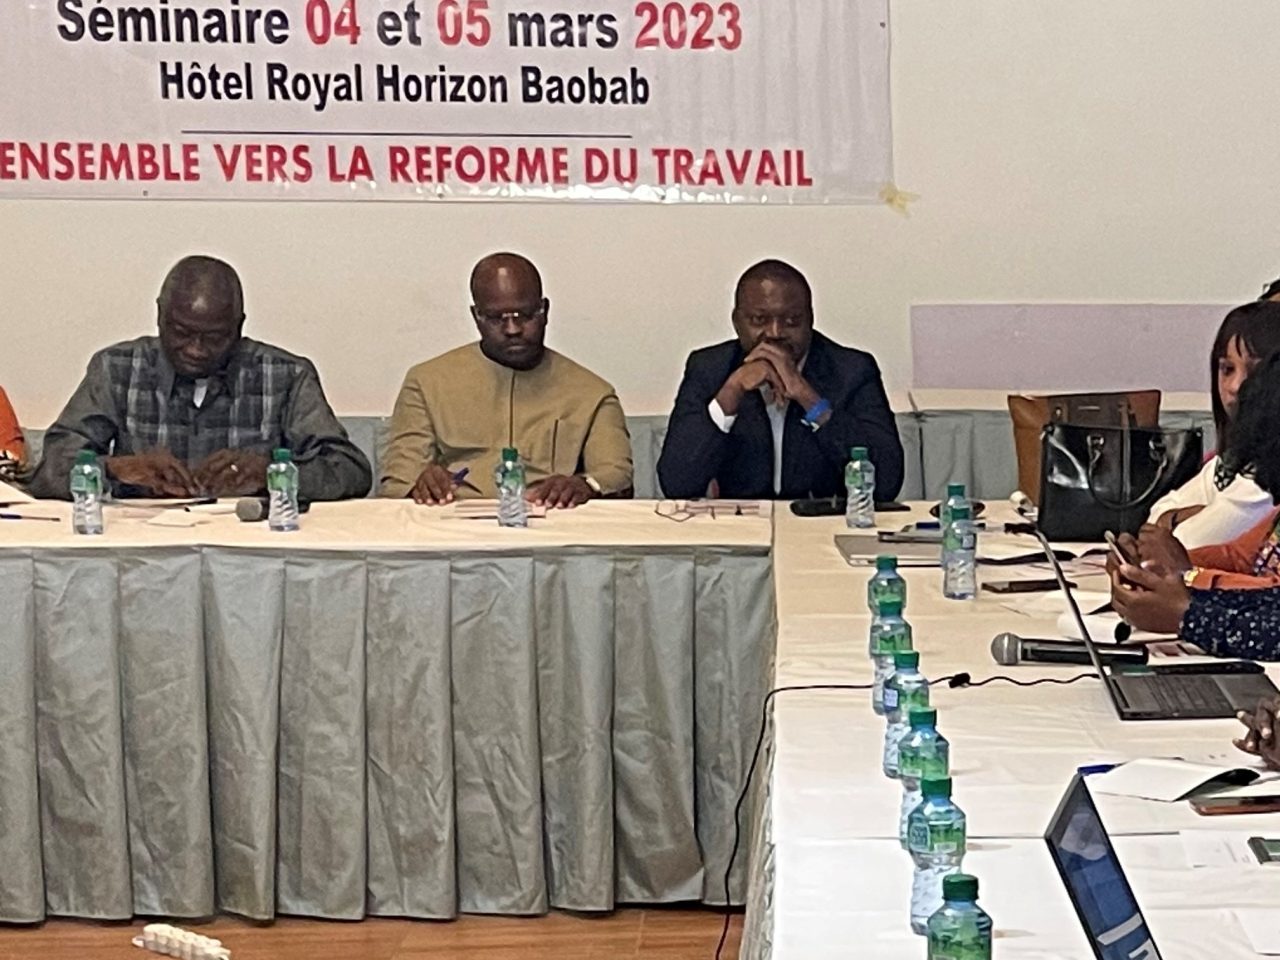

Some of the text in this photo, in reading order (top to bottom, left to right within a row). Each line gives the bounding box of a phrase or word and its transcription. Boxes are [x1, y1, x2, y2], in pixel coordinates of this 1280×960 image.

[57, 0, 743, 50] Séminaire 04 et 05 mars 2023
[160, 61, 649, 112] Hôtel Royal Horizon Baobab
[0, 142, 813, 187] ENSEMBLE VERS LA REFORME DU TRAVAIL
